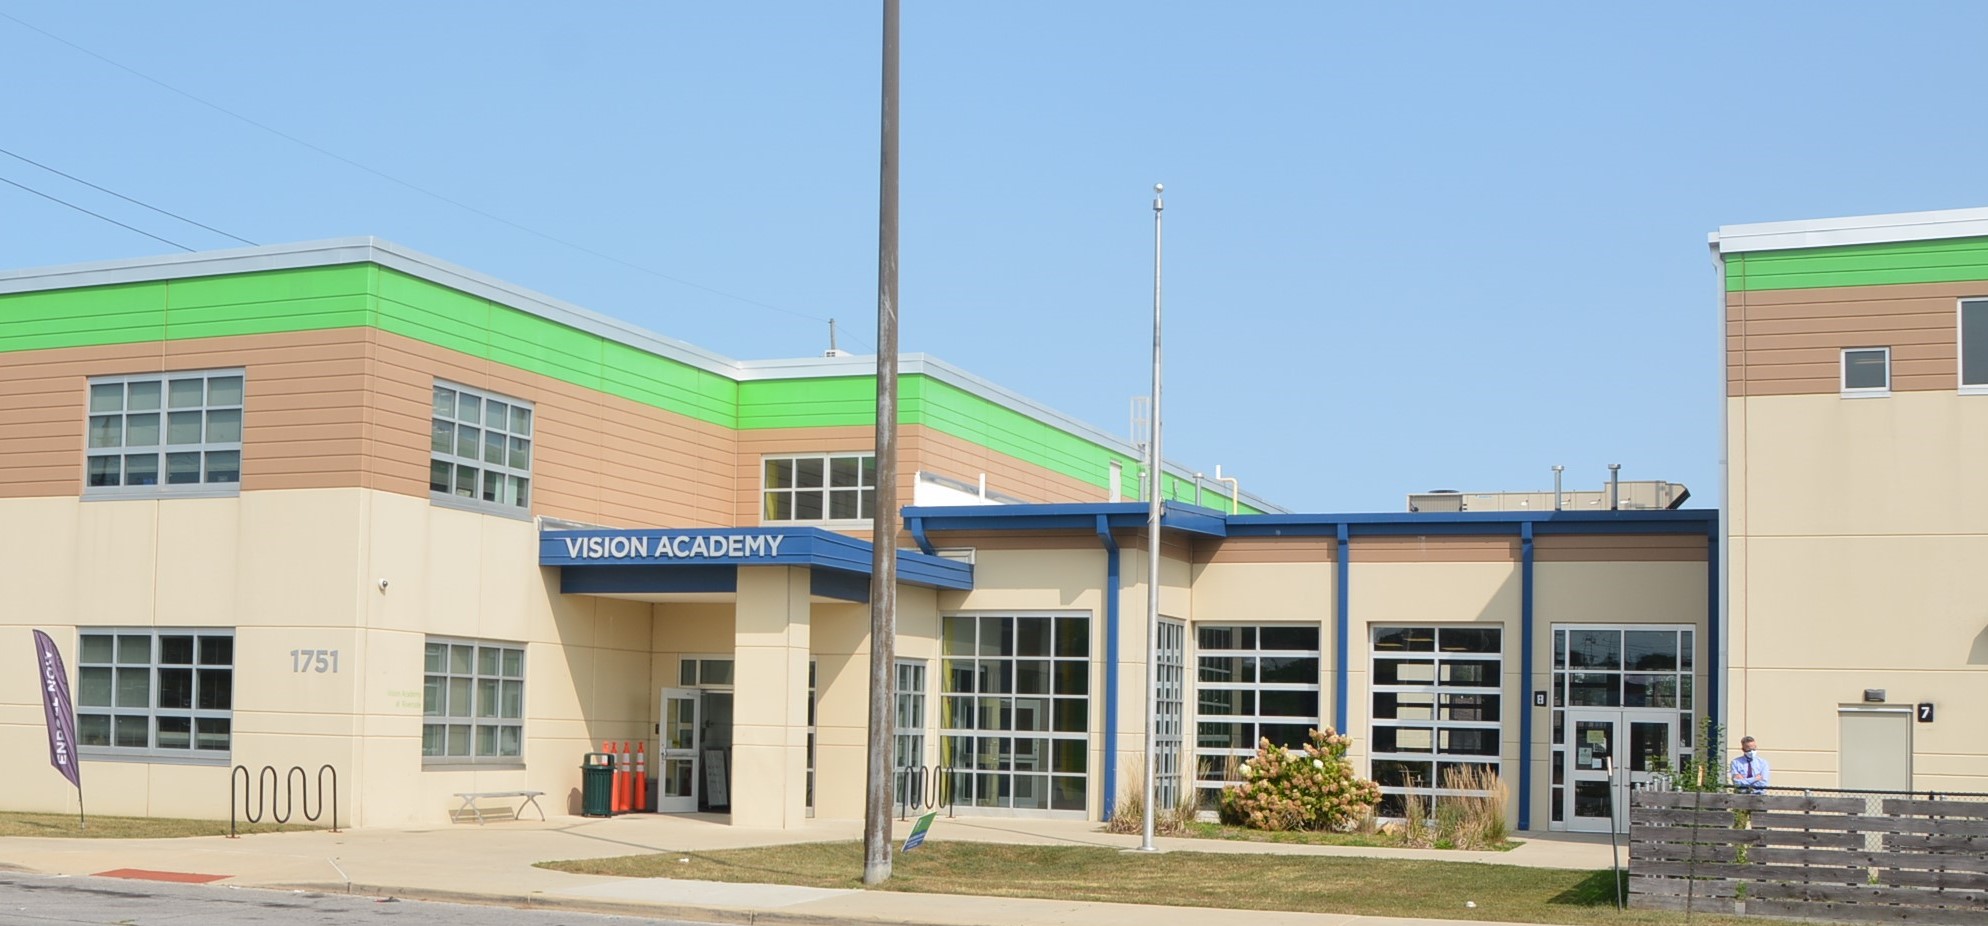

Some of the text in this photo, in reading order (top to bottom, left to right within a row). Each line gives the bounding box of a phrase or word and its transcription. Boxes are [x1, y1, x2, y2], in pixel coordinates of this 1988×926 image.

[566, 534, 784, 559] VISION ACADEMY
[290, 649, 339, 673] 1751
[1537, 694, 1544, 705] 8
[1921, 706, 1930, 719] 7
